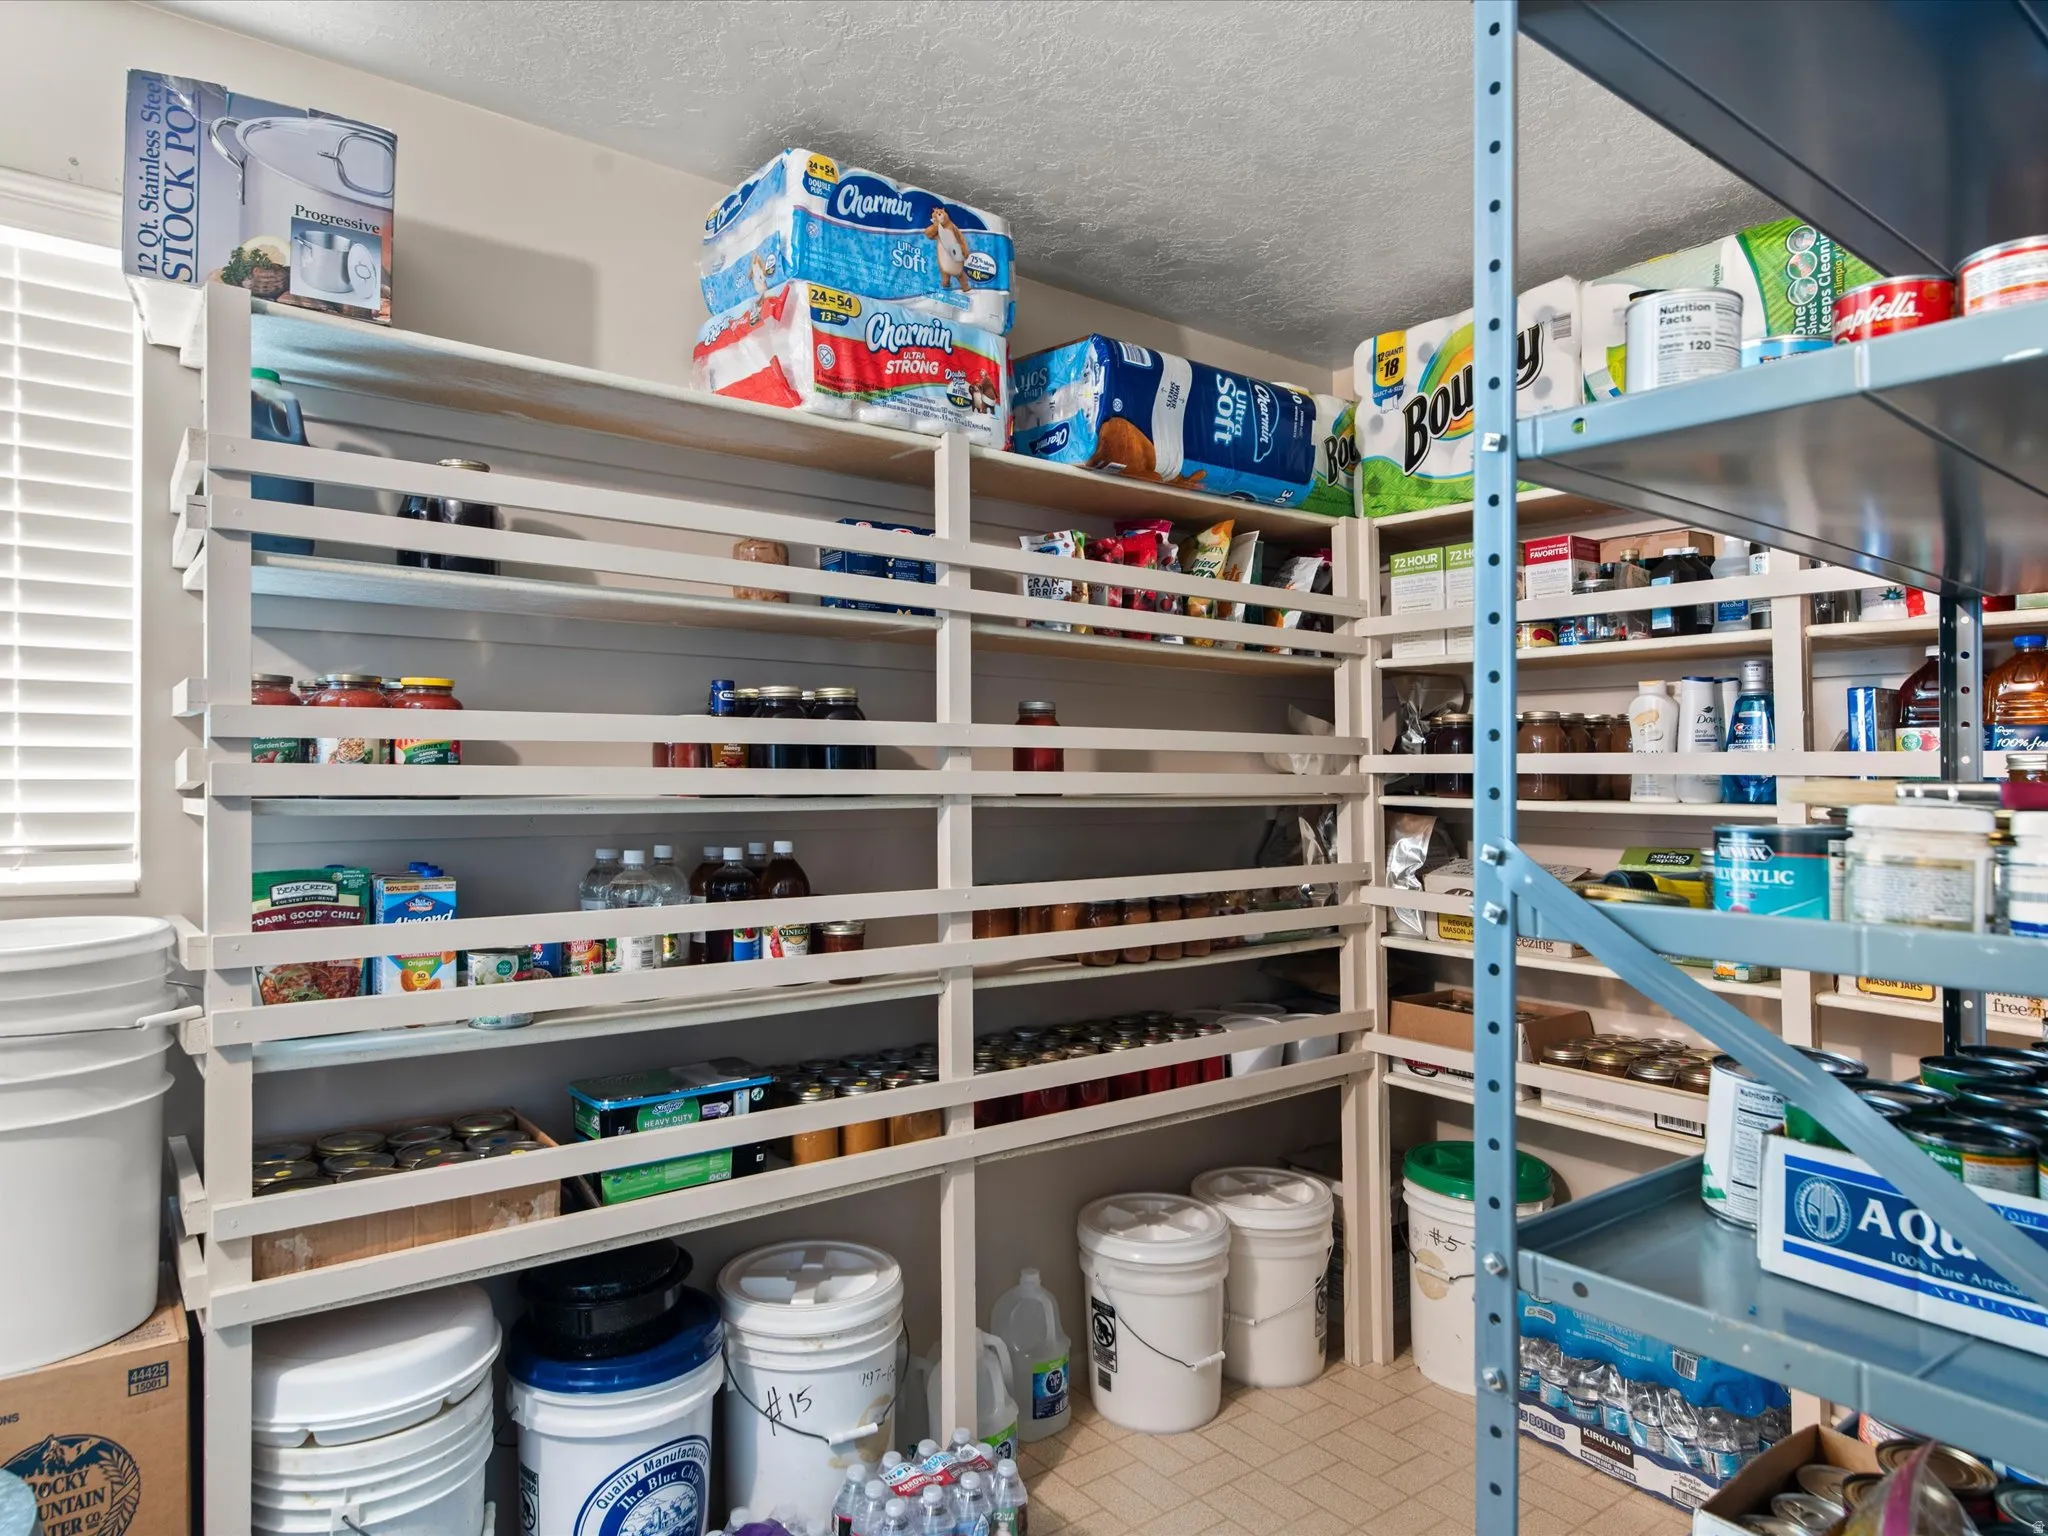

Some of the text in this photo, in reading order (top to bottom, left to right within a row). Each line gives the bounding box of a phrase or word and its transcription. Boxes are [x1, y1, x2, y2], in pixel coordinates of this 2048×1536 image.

[137, 75, 162, 274] 12 Qt. Stainless Steel
[161, 88, 200, 284] STOCK POT
[808, 178, 832, 193] DOUBLE
[837, 183, 914, 222] Charmin
[294, 204, 380, 234] Progressive
[897, 240, 921, 254] Ultra
[892, 249, 927, 274] Soft
[1816, 233, 1833, 334] Keeps Cleani
[1659, 302, 1711, 316] Nutrition
[1659, 315, 1692, 326] Facts
[1793, 306, 1807, 335] One
[1807, 302, 1818, 335] Sheet
[866, 312, 954, 355] Charmin
[1688, 340, 1712, 351] 120
[903, 351, 926, 360] ULTRA
[1377, 352, 1385, 364] 12
[884, 360, 939, 376] STRONG
[1384, 356, 1400, 379] 18
[1166, 381, 1176, 410] SHEETS
[1171, 384, 1181, 411] WIDER
[1402, 322, 1545, 477] Bouy
[1215, 373, 1237, 446] Soft
[1233, 389, 1248, 437] Ultra
[1254, 384, 1272, 444] Charmin
[1394, 553, 1438, 569] 72 HOUR
[1449, 550, 1462, 561] 72
[1530, 547, 1569, 559] FAVORITES
[1027, 577, 1064, 589] CRAN-
[1720, 601, 1745, 609] Alcohol
[1696, 714, 1722, 725] Dove
[1995, 726, 2016, 736] Kroger
[253, 742, 279, 750] Garden
[412, 743, 444, 753] CHUNKY
[1996, 737, 2029, 748] 100%
[276, 883, 334, 895] BEAR CREEK
[330, 910, 361, 920] CHILI
[1442, 926, 1466, 935] MASON
[1447, 919, 1473, 928] REGULA
[780, 928, 809, 936] VINEGA
[1515, 937, 1554, 953] eezing
[407, 960, 435, 968] Original
[1865, 976, 1924, 992] MASON JARS
[1739, 1088, 1771, 1101] Nutrition
[652, 1099, 685, 1116] Swiffer
[644, 1113, 694, 1128] HEAVY DUTY
[1736, 1115, 1770, 1129] Calories
[1996, 1205, 2039, 1226] Your
[1429, 1227, 1467, 1252] #5
[1891, 1251, 1929, 1272] 100%
[1931, 1263, 1966, 1281] Pure
[130, 1363, 167, 1383] 44425
[135, 1378, 162, 1393] 15001
[1529, 1412, 1566, 1440] BOTTLES
[1583, 1427, 1632, 1456] KIRKLAND
[1581, 1451, 1613, 1472] DRINKING
[1613, 1465, 1636, 1482] WATER
[29, 1469, 90, 1497] ROCKY
[595, 1446, 708, 1511] Quality Manufacturers
[898, 1474, 943, 1492] ARROWAD
[616, 1463, 700, 1511] The Blue Chip
[38, 1486, 106, 1522] UNTAIN
[47, 1516, 83, 1536] TER
